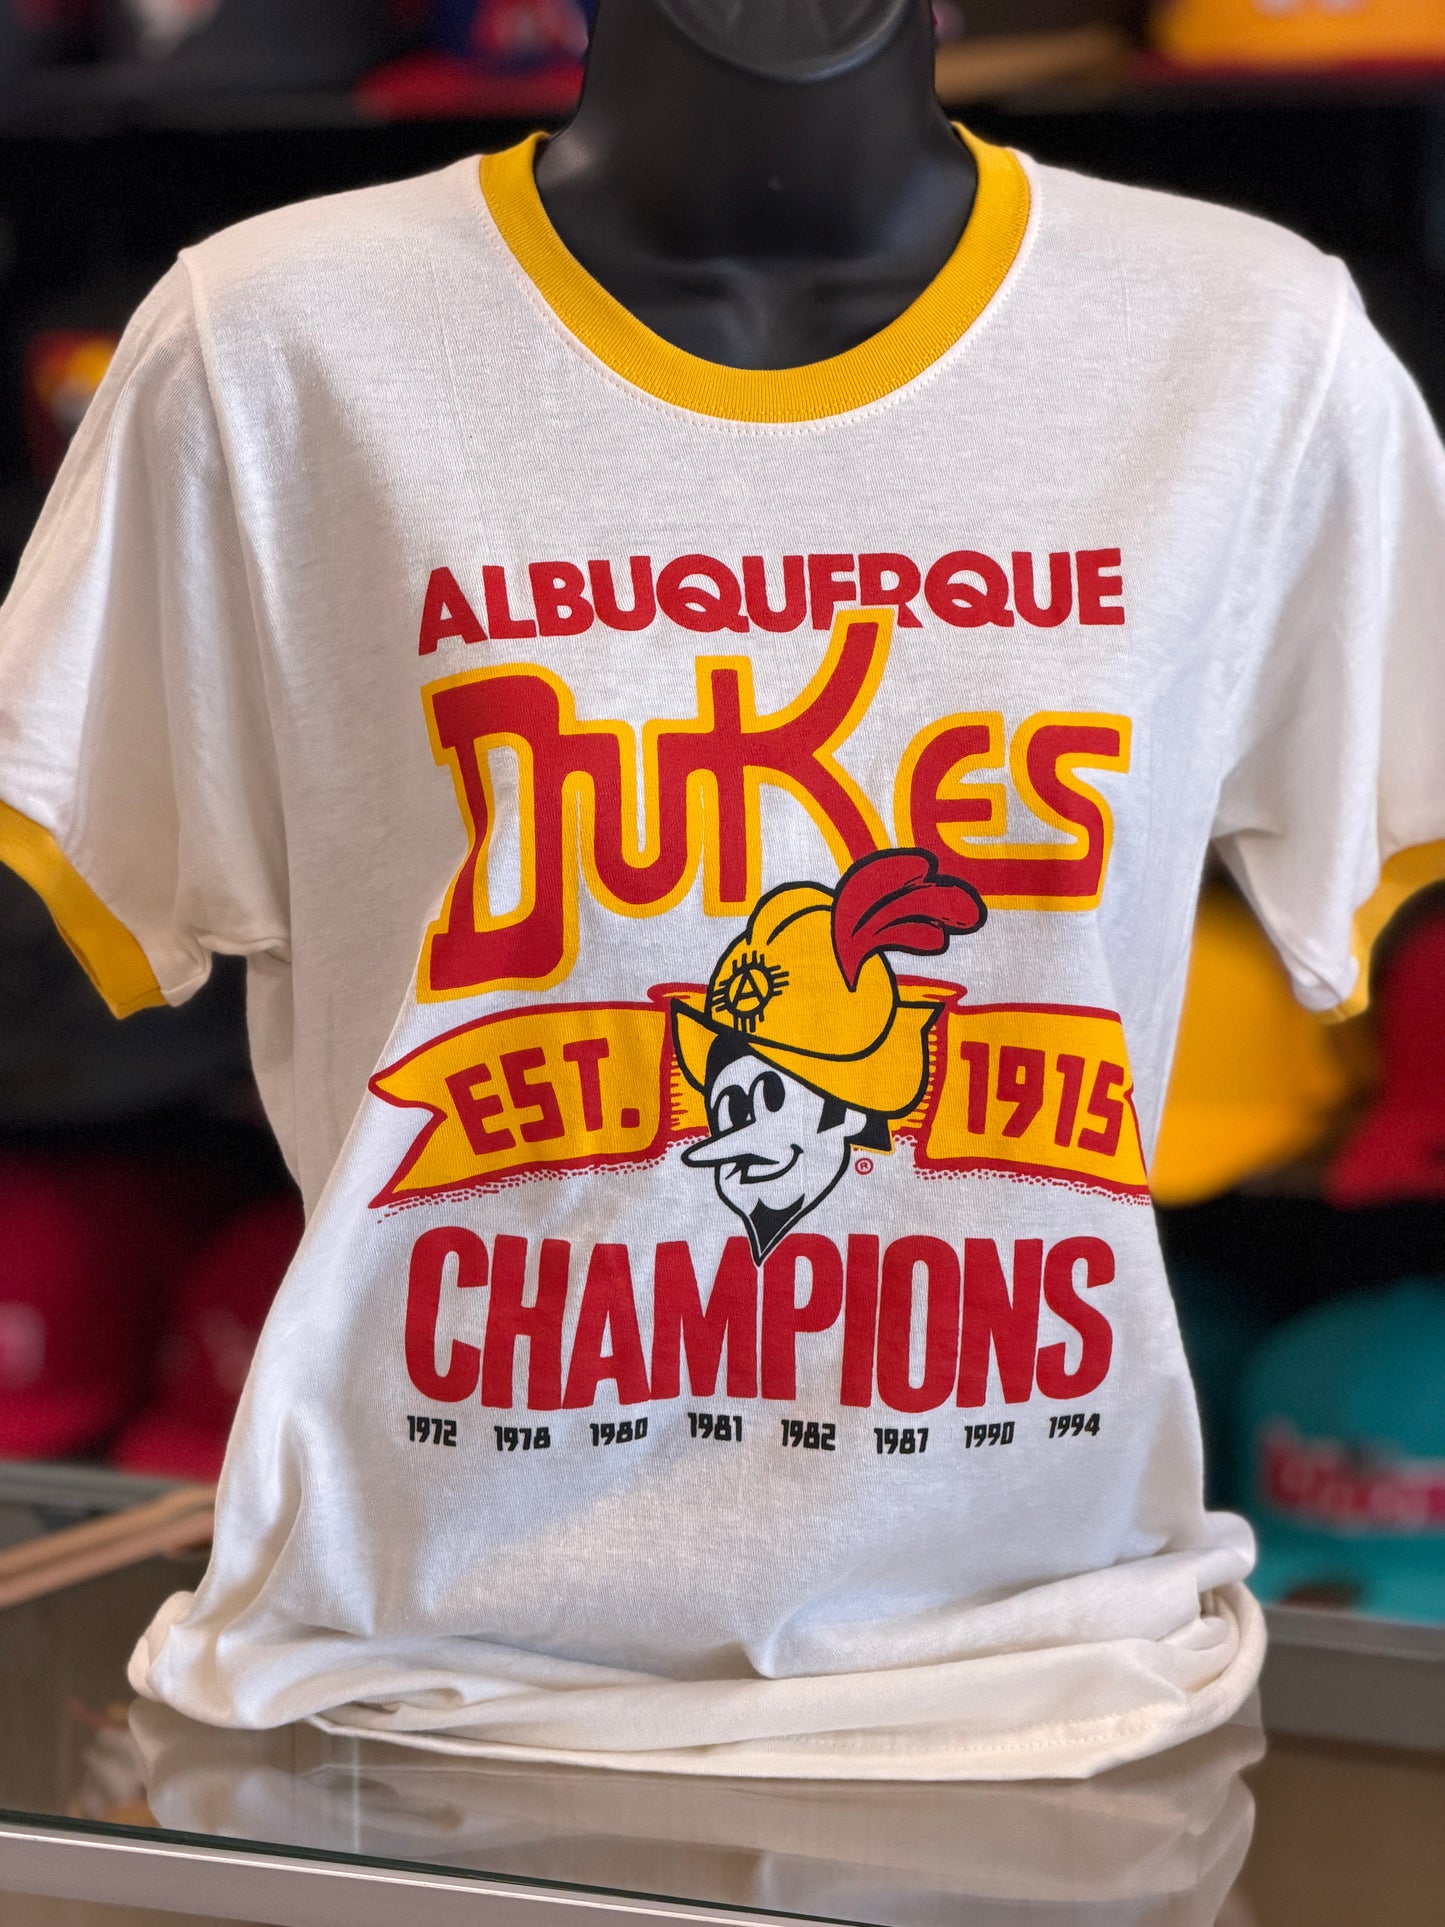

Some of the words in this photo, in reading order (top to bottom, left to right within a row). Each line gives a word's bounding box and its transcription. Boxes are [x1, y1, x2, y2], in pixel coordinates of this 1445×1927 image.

[418, 548, 1125, 655] ALBUQUERQUE
[445, 1037, 639, 1156] EST.
[405, 1226, 1116, 1411] CHAMPIONS
[407, 1415, 457, 1447] 1972
[494, 1425, 551, 1452] 1978
[589, 1417, 648, 1447] 1980
[687, 1412, 743, 1442] 1981
[780, 1419, 836, 1451] 1982
[873, 1427, 929, 1454] 1987
[964, 1421, 1015, 1449] 1990
[1049, 1413, 1101, 1439] 1994
